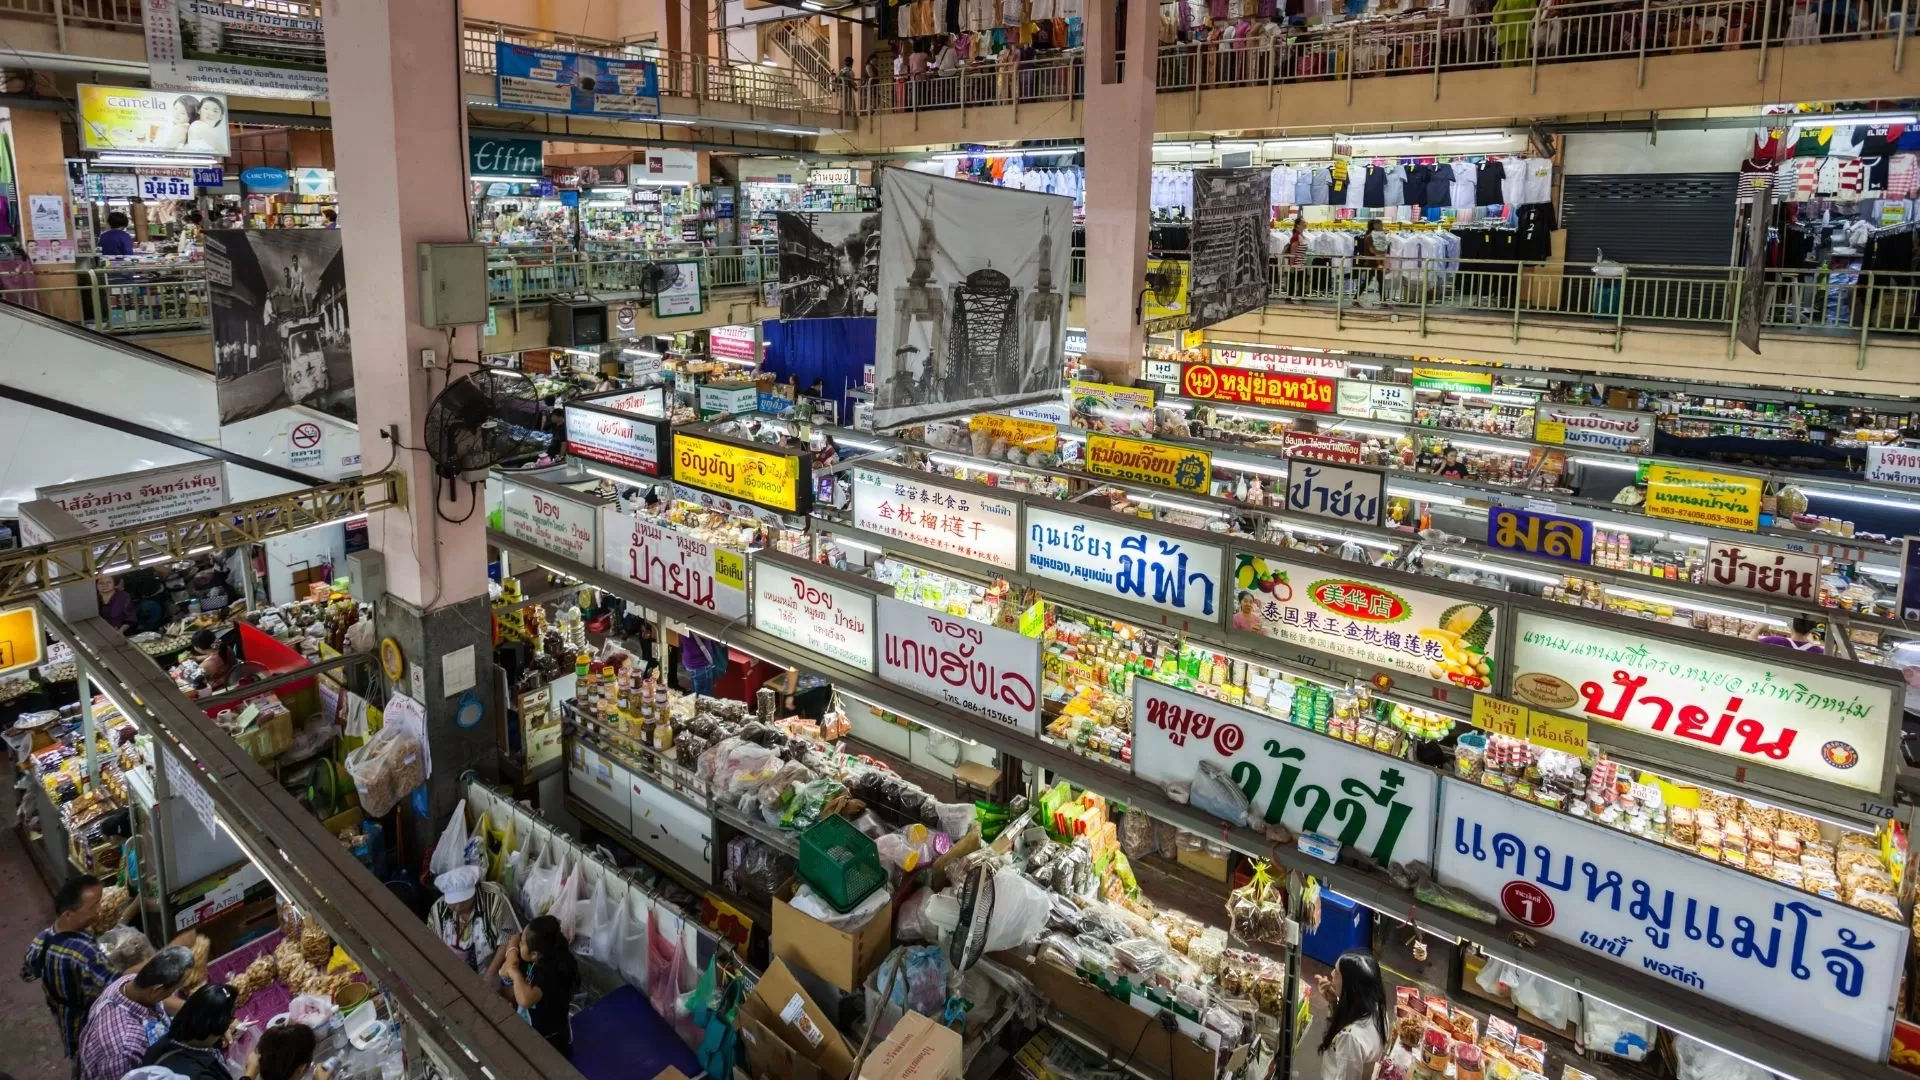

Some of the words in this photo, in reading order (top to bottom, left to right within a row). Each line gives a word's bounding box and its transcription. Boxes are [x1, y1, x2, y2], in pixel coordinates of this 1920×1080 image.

[532, 494, 560, 520] จอย
[894, 483, 970, 512] 经营泰北食品
[1291, 467, 1377, 522] ป้าย่น
[1031, 523, 1112, 560] กุนเชียง
[1496, 512, 1584, 560] มล
[629, 532, 715, 610] ป้าย่น
[790, 577, 833, 610] จอย
[1115, 534, 1215, 616] มีฟ้า
[1711, 548, 1813, 599] ป้าย่น
[1322, 584, 1394, 619] 美华店
[927, 615, 983, 645] จอย
[885, 633, 1036, 713] แกงฮังเล
[1146, 697, 1245, 757] หมูยอ
[1580, 669, 1798, 761] ป้าย่น
[1860, 801, 1895, 820] 1/78
[1455, 816, 1876, 998] แคบหมูแม่โจ้
[1520, 899, 1535, 924] 1
